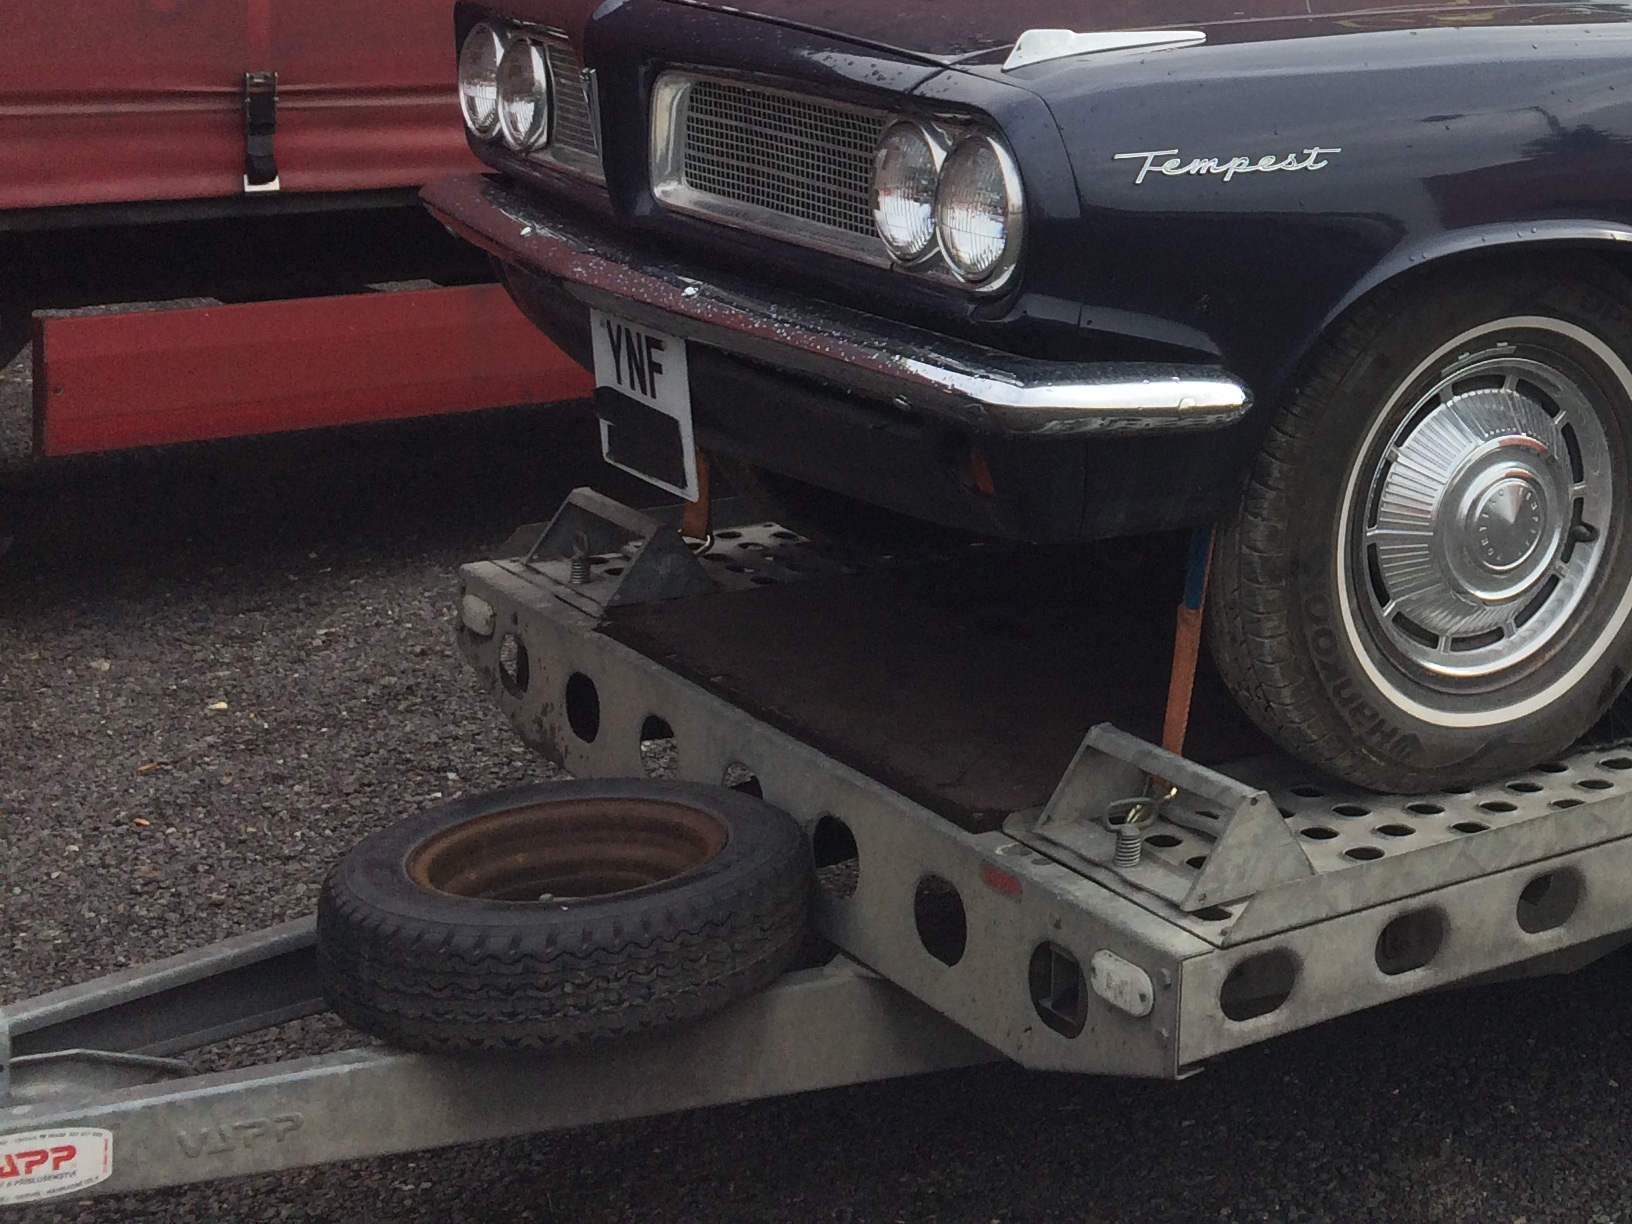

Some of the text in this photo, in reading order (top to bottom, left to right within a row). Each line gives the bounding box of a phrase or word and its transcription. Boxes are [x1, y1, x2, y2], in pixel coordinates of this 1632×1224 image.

[1113, 146, 1342, 184] Tempest
[606, 319, 665, 400] YNF
[0, 1144, 77, 1178] APP
